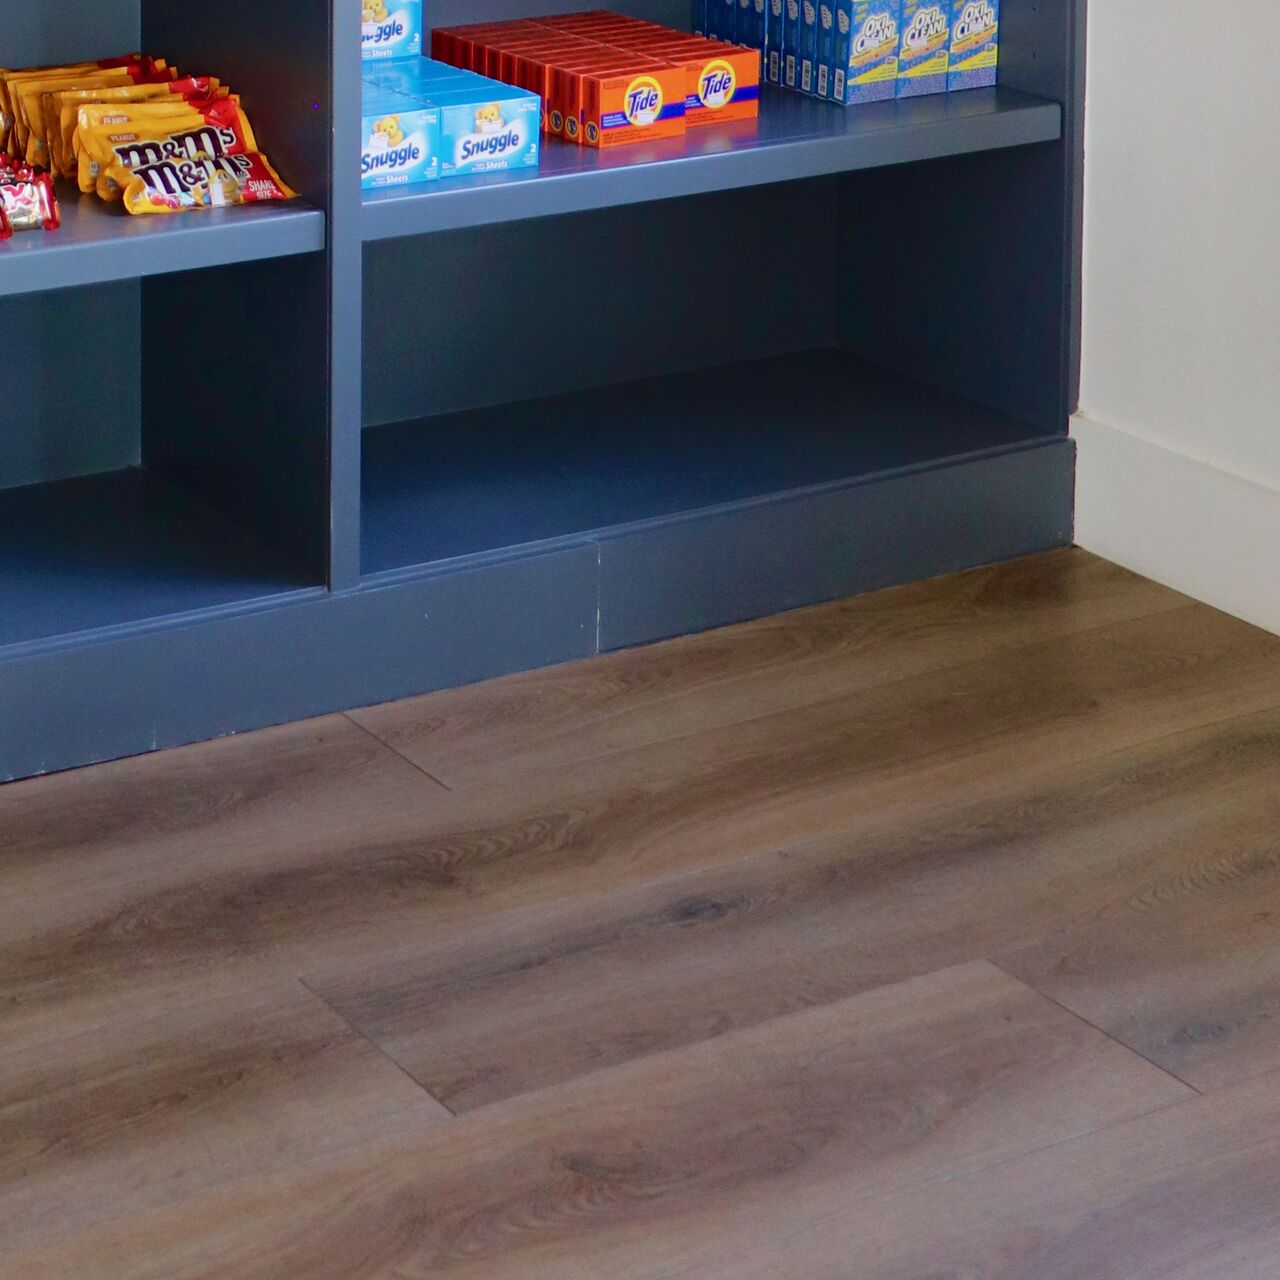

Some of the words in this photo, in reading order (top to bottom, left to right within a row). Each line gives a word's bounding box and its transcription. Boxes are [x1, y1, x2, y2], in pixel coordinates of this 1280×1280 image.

[915, 9, 937, 30] OXI
[964, 2, 986, 23] OXI
[865, 15, 888, 37] OXI
[907, 17, 944, 47] CLEAN
[372, 48, 392, 57] Sheets
[702, 71, 731, 100] Tide
[628, 88, 658, 118] Tide
[103, 117, 128, 125] PEANUT
[461, 130, 519, 160] Snuggle
[361, 144, 420, 173] Snuggle
[486, 159, 508, 169] Sheets
[248, 180, 276, 191] SHARE
[385, 174, 408, 183] Sheets
[257, 191, 272, 199] SIZE
